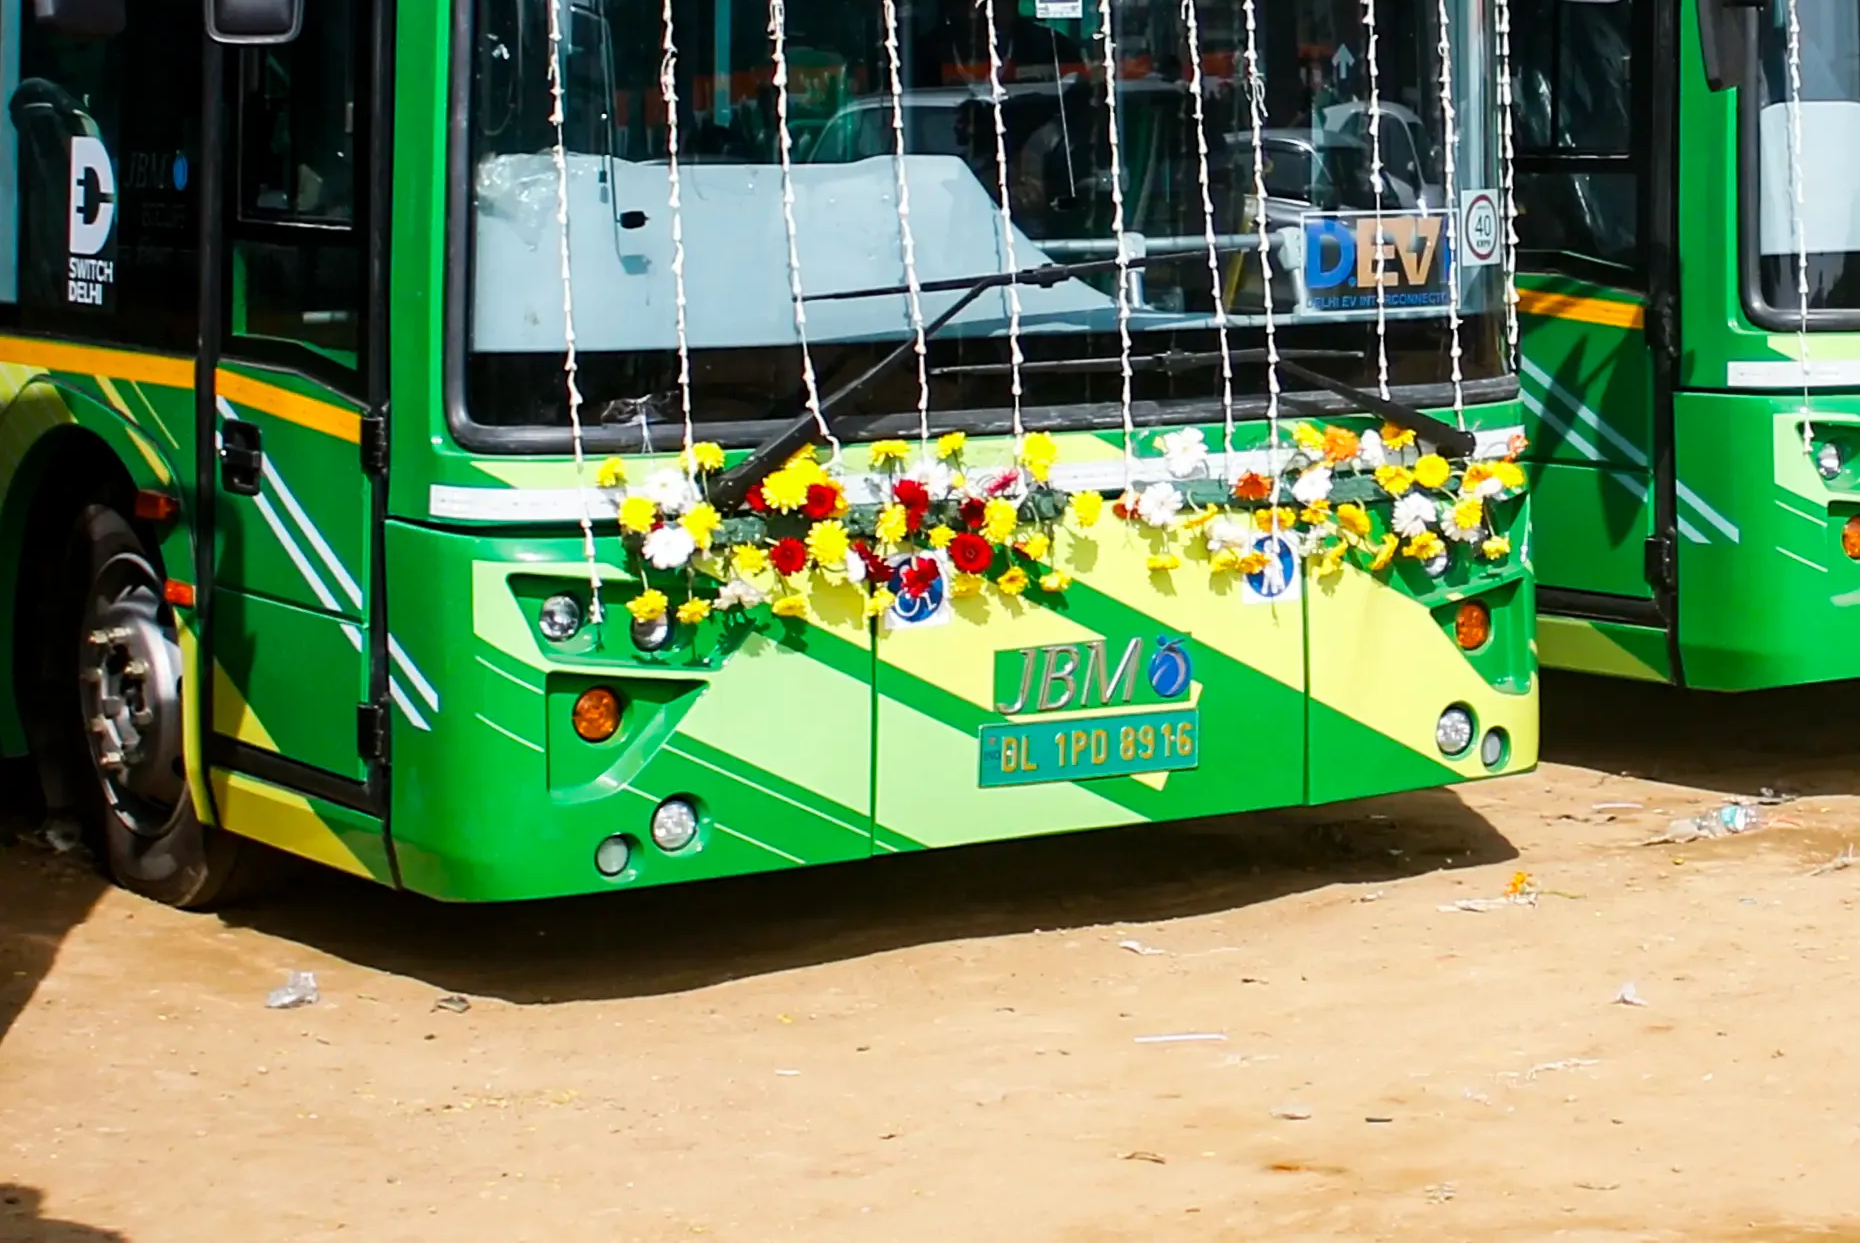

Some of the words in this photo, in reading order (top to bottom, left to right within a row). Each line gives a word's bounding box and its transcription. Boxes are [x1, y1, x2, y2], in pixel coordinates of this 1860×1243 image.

[1475, 215, 1491, 237] 40
[69, 258, 113, 283] SWITCH
[68, 280, 103, 305] DELHI
[997, 637, 1143, 714] JBM
[1055, 728, 1108, 767] 1PD
[1120, 722, 1193, 761] 8916
